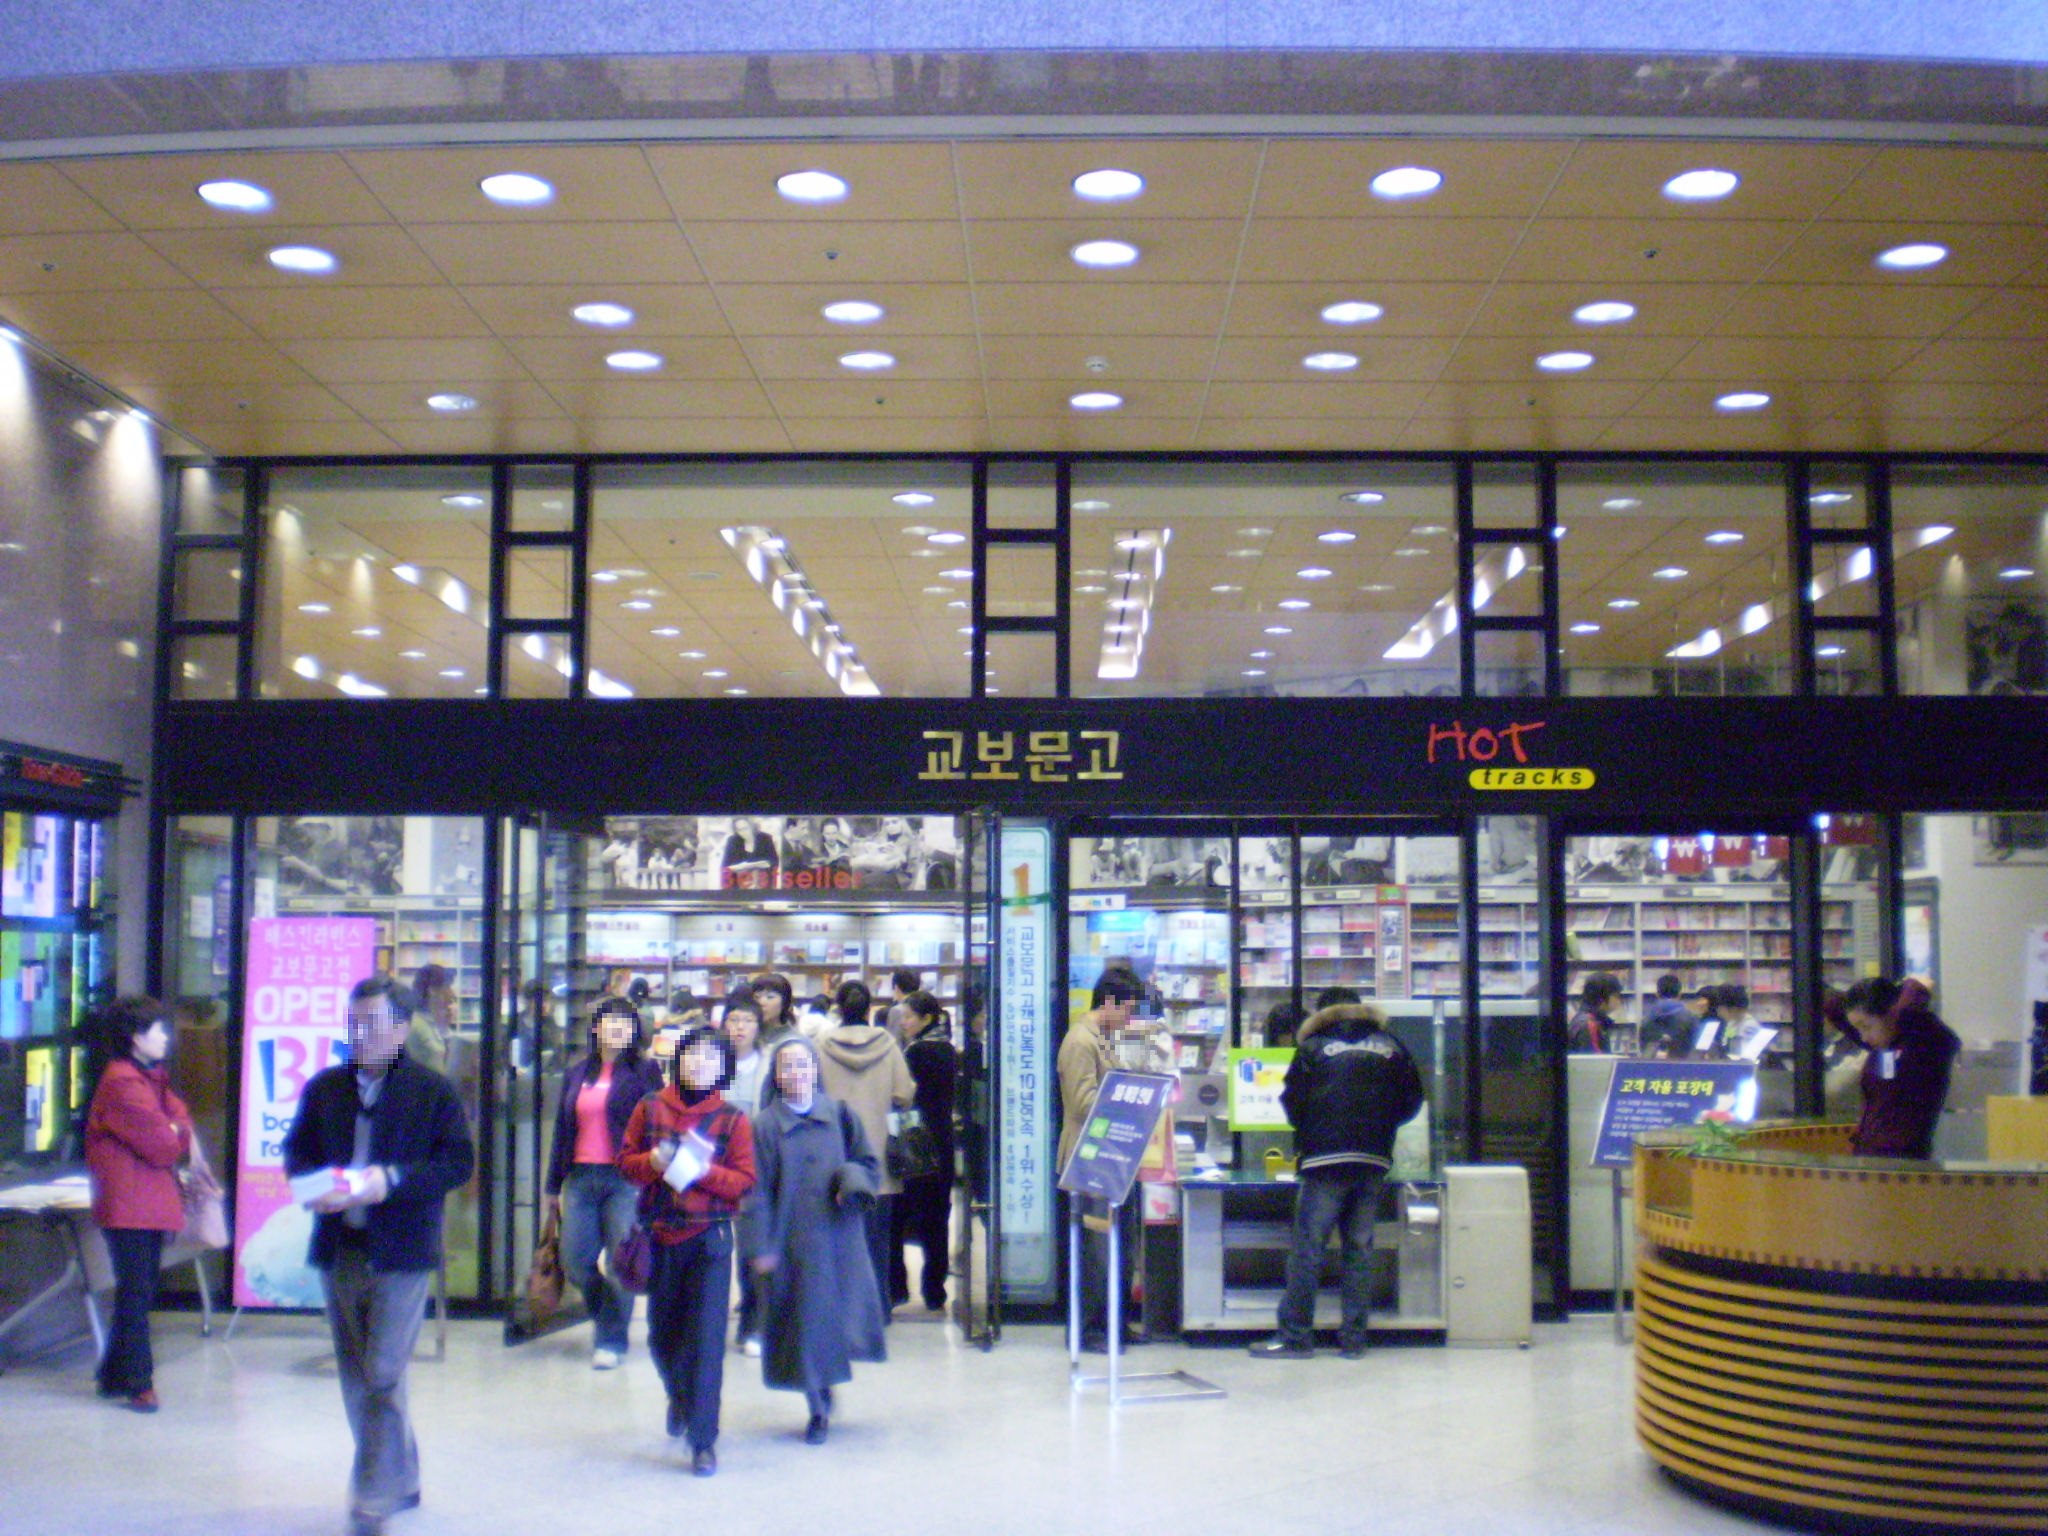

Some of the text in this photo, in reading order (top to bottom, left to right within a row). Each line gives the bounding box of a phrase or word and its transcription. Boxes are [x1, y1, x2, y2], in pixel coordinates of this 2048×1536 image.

[918, 730, 1124, 782] 교보문고
[1483, 769, 1583, 785] tracks
[269, 954, 352, 982] 교보문고점
[1020, 926, 1034, 986] 교보문고
[1020, 993, 1035, 1069] 고객만족도
[1620, 1079, 1646, 1094] 고객
